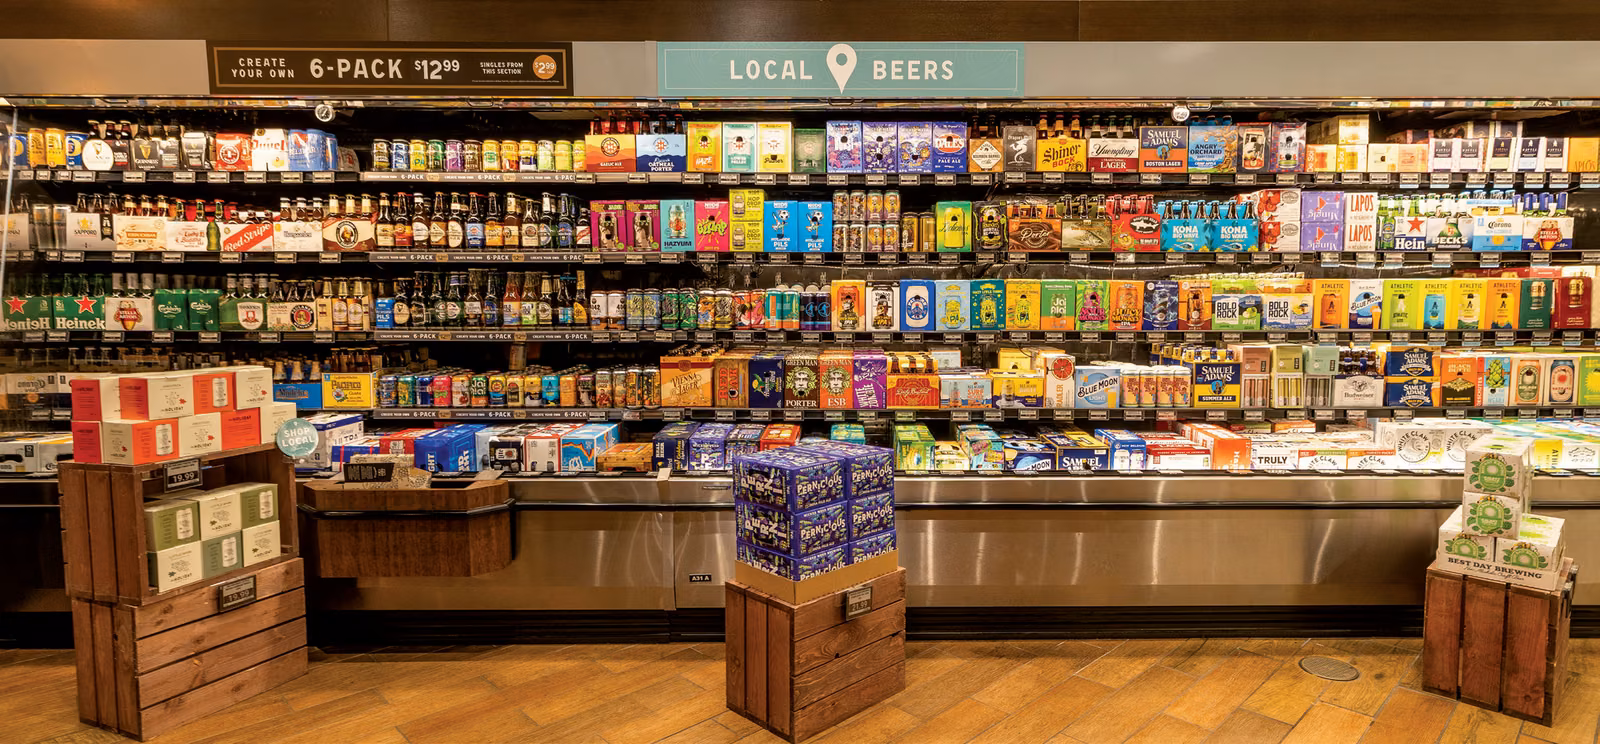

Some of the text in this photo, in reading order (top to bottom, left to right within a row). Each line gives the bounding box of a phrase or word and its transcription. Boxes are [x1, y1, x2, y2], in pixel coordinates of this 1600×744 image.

[238, 58, 286, 67] CREATE
[231, 69, 294, 78] YOUR OWN
[310, 58, 403, 79] 6-PACK
[730, 60, 954, 80] LOCAL BEERS
[1148, 129, 1181, 139] SAMUEL
[1150, 137, 1178, 146] ADAMS
[1044, 144, 1082, 163] Shiner
[1089, 143, 1135, 156] Yuengling
[1307, 148, 1315, 162] Soi
[1052, 156, 1075, 168] BOCK
[1100, 161, 1127, 169] LAGER
[1350, 194, 1374, 212] LAPOS
[1308, 209, 1339, 221] Mingle
[1173, 225, 1198, 233] KONA
[1220, 226, 1247, 234] KONA
[1488, 221, 1512, 230] Corona
[225, 222, 271, 251] Red Stripe
[1020, 227, 1050, 241] Porter
[1349, 224, 1373, 242] LAPOS
[1394, 237, 1426, 250] Hein
[1053, 297, 1066, 306] Jai
[1217, 302, 1237, 310] BOLD
[1268, 301, 1289, 310] BOLD
[1351, 295, 1381, 310] BLUE MOON
[158, 303, 181, 313] Carlsberg
[1051, 306, 1066, 314] Alai
[1081, 307, 1106, 315] SOUR
[1115, 307, 1141, 315] JUICY
[1268, 309, 1289, 318] ROCK
[1216, 310, 1237, 319] ROCK
[55, 317, 106, 329] Heinek
[1202, 366, 1235, 374] SAMUEL
[672, 372, 697, 387] VIENNA
[1204, 373, 1232, 381] ADAMS
[473, 379, 486, 389] Jai
[679, 380, 699, 396] LAGER
[718, 367, 728, 400] RED
[1078, 377, 1118, 397] BLUE MOON
[828, 397, 846, 406] ESB
[284, 427, 310, 438] SHOP
[282, 435, 314, 447] LOCAL
[1398, 430, 1429, 451] WHITE CLAW
[1446, 430, 1477, 450] WHITE CLAW
[1031, 460, 1050, 470] MOON
[1258, 456, 1288, 464] TRULY
[1320, 455, 1337, 466] CLAW
[1368, 455, 1386, 466] CLAW
[173, 472, 195, 483] 19.99
[851, 463, 893, 483] PERNICIOUS
[797, 475, 843, 494] PERNICIOUS
[853, 503, 893, 524] PERNICIOUS
[800, 517, 846, 539] PERNICIOUS
[1448, 557, 1471, 567] BEST
[1473, 562, 1492, 571] DAY
[1495, 566, 1542, 579] BREWING
[228, 590, 250, 602] 19.99
[852, 601, 868, 612] 21.99
